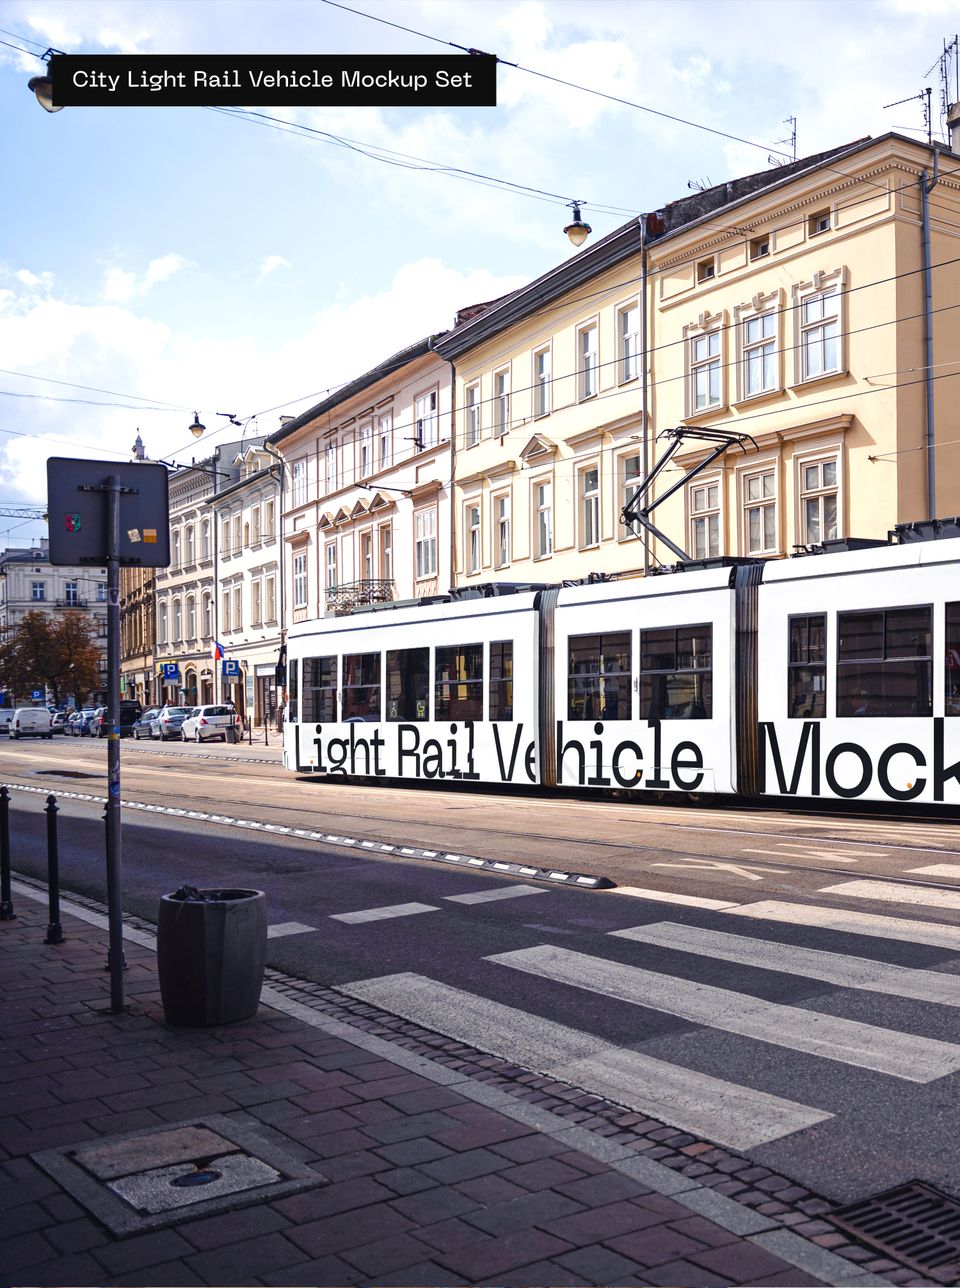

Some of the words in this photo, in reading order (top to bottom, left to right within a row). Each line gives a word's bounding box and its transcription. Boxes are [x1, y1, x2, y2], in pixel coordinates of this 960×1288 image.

[225, 661, 235, 673] P
[295, 722, 385, 777] Light
[398, 721, 480, 781] Rail
